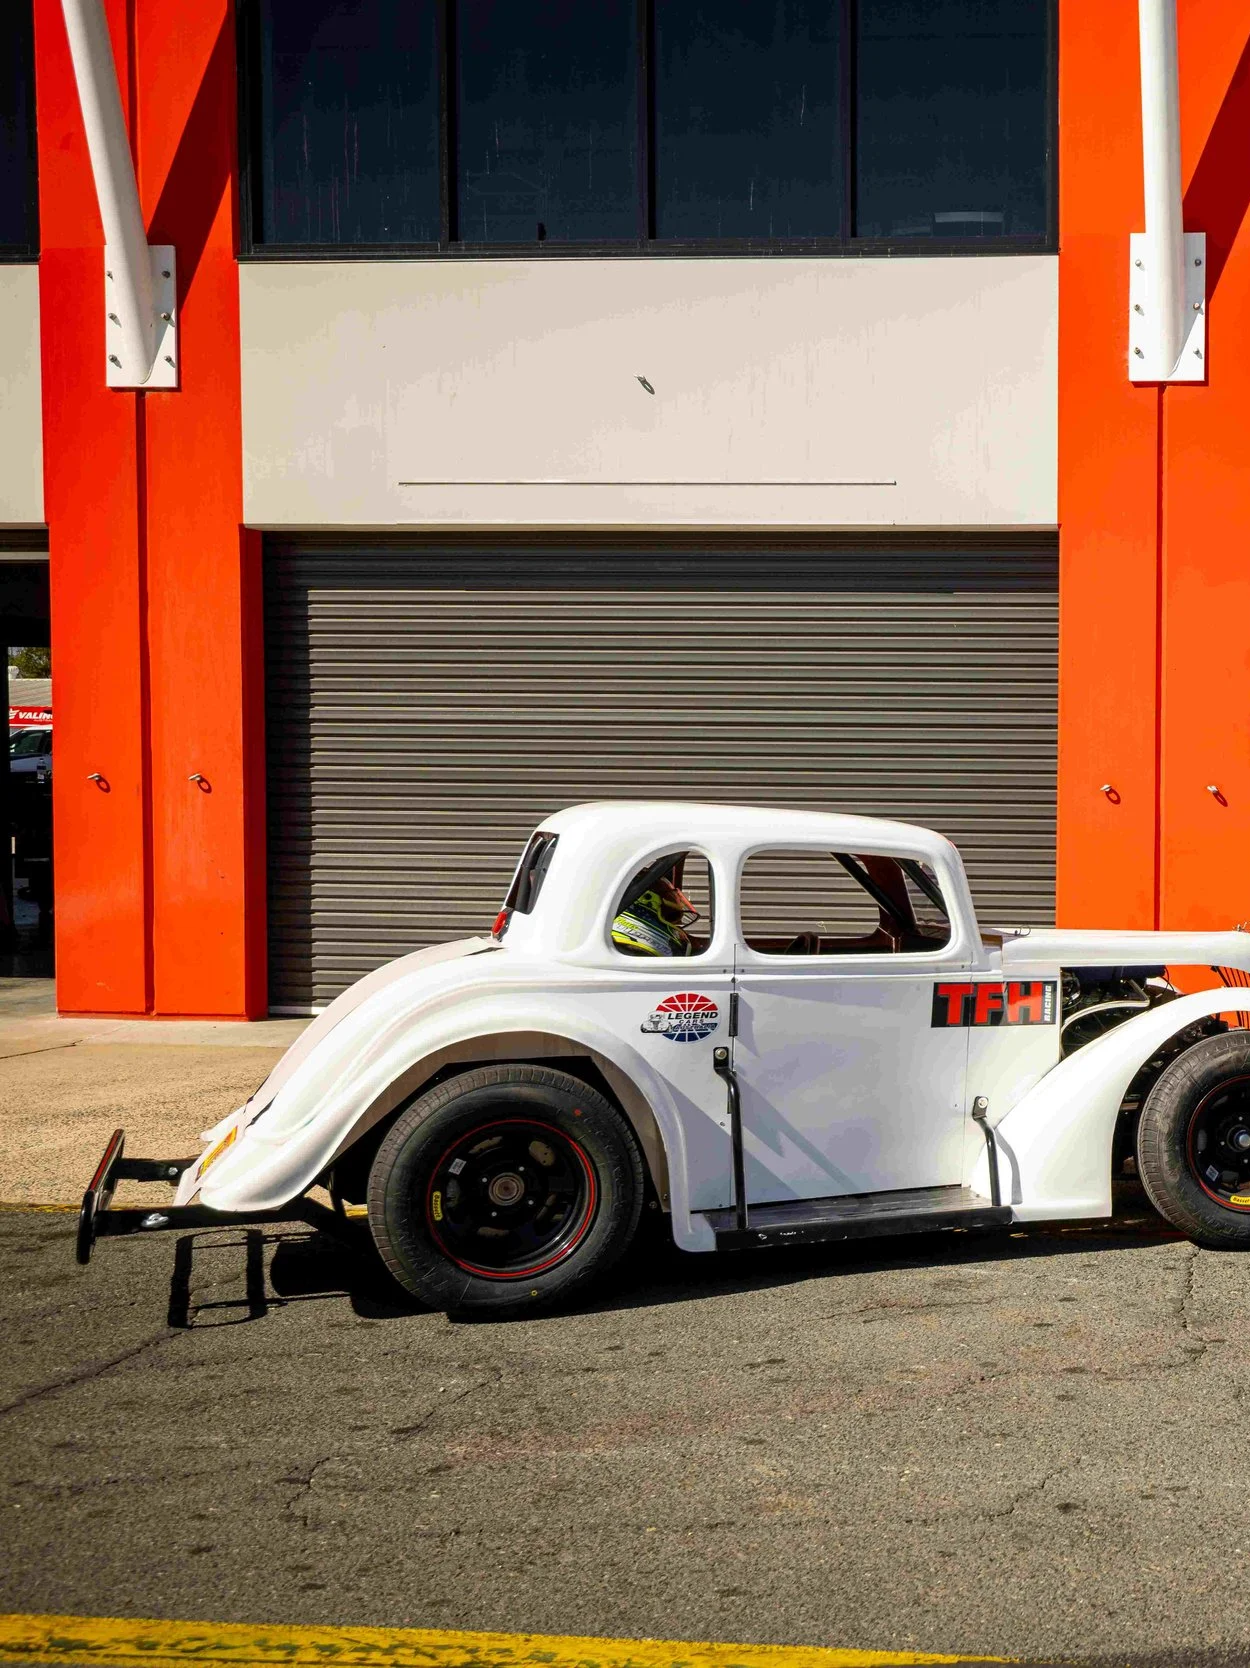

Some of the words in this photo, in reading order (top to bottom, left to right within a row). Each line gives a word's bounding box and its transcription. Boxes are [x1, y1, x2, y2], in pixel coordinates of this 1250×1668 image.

[19, 711, 53, 719] VALIN
[937, 982, 1043, 1023] TFH
[1043, 984, 1053, 1022] RACING
[667, 1011, 719, 1020] LEGEND
